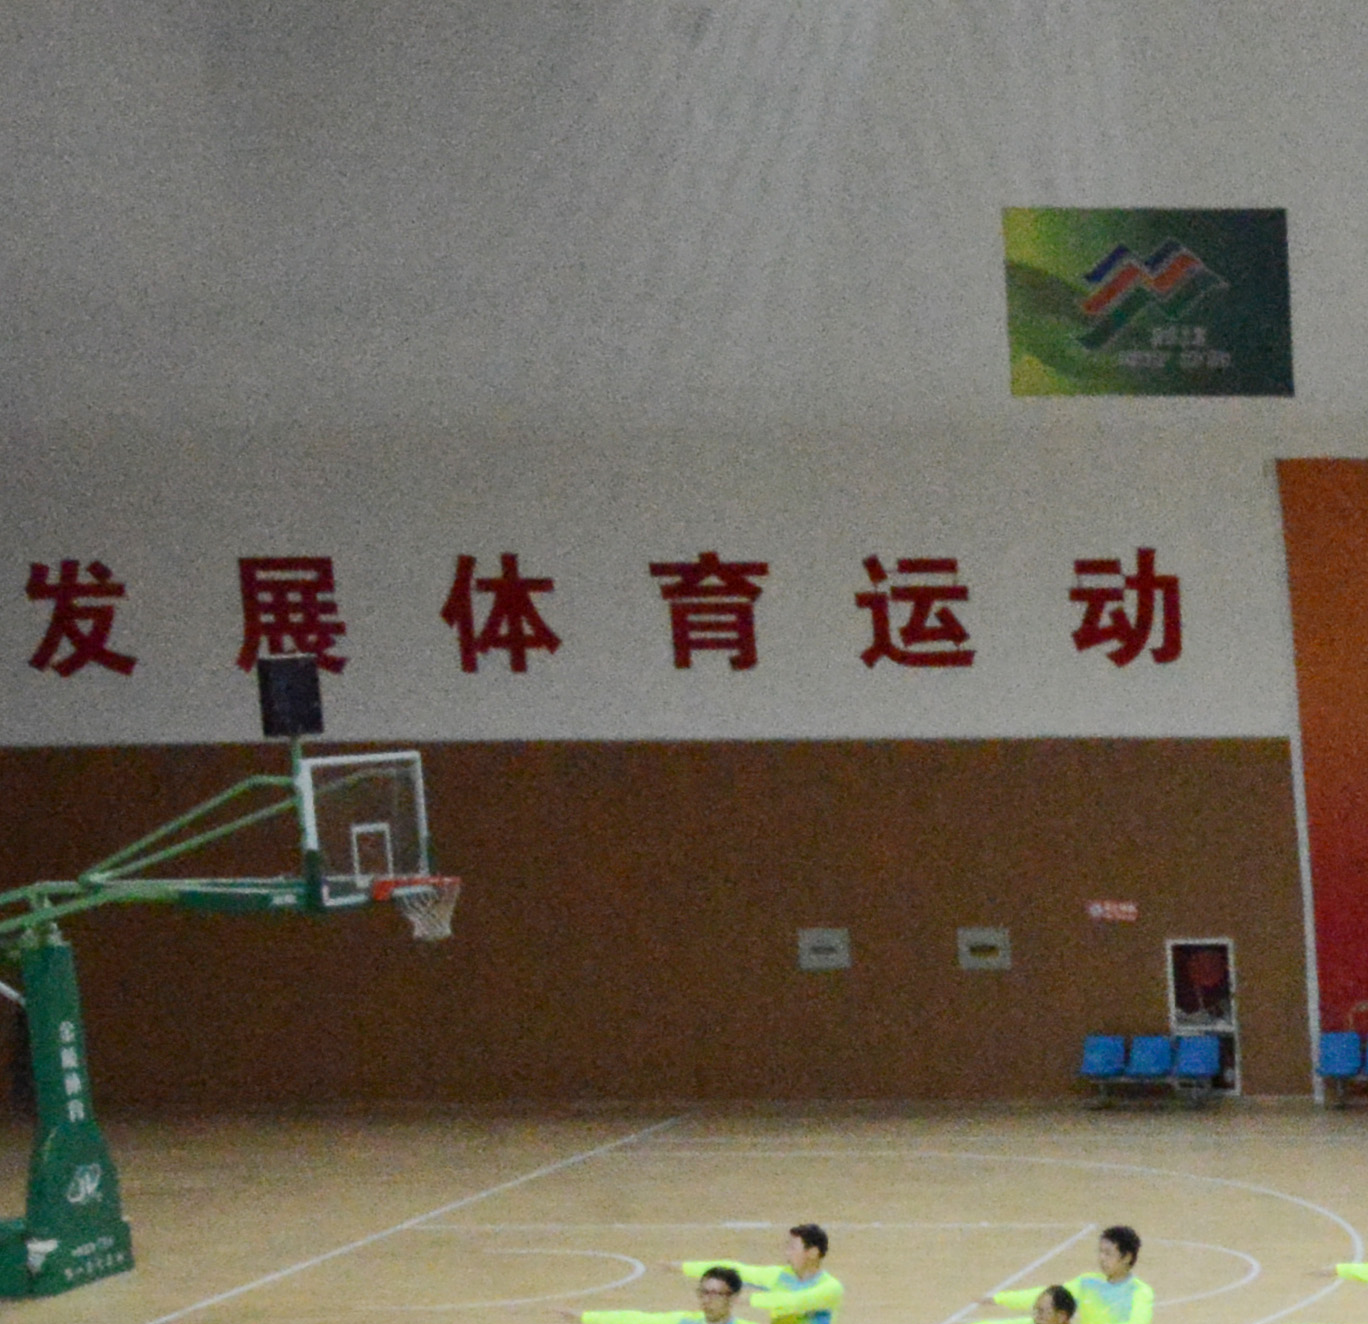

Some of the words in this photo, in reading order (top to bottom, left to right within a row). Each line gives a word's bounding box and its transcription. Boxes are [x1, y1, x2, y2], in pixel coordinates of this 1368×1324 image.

[25, 547, 1183, 678] 发展体育运动
